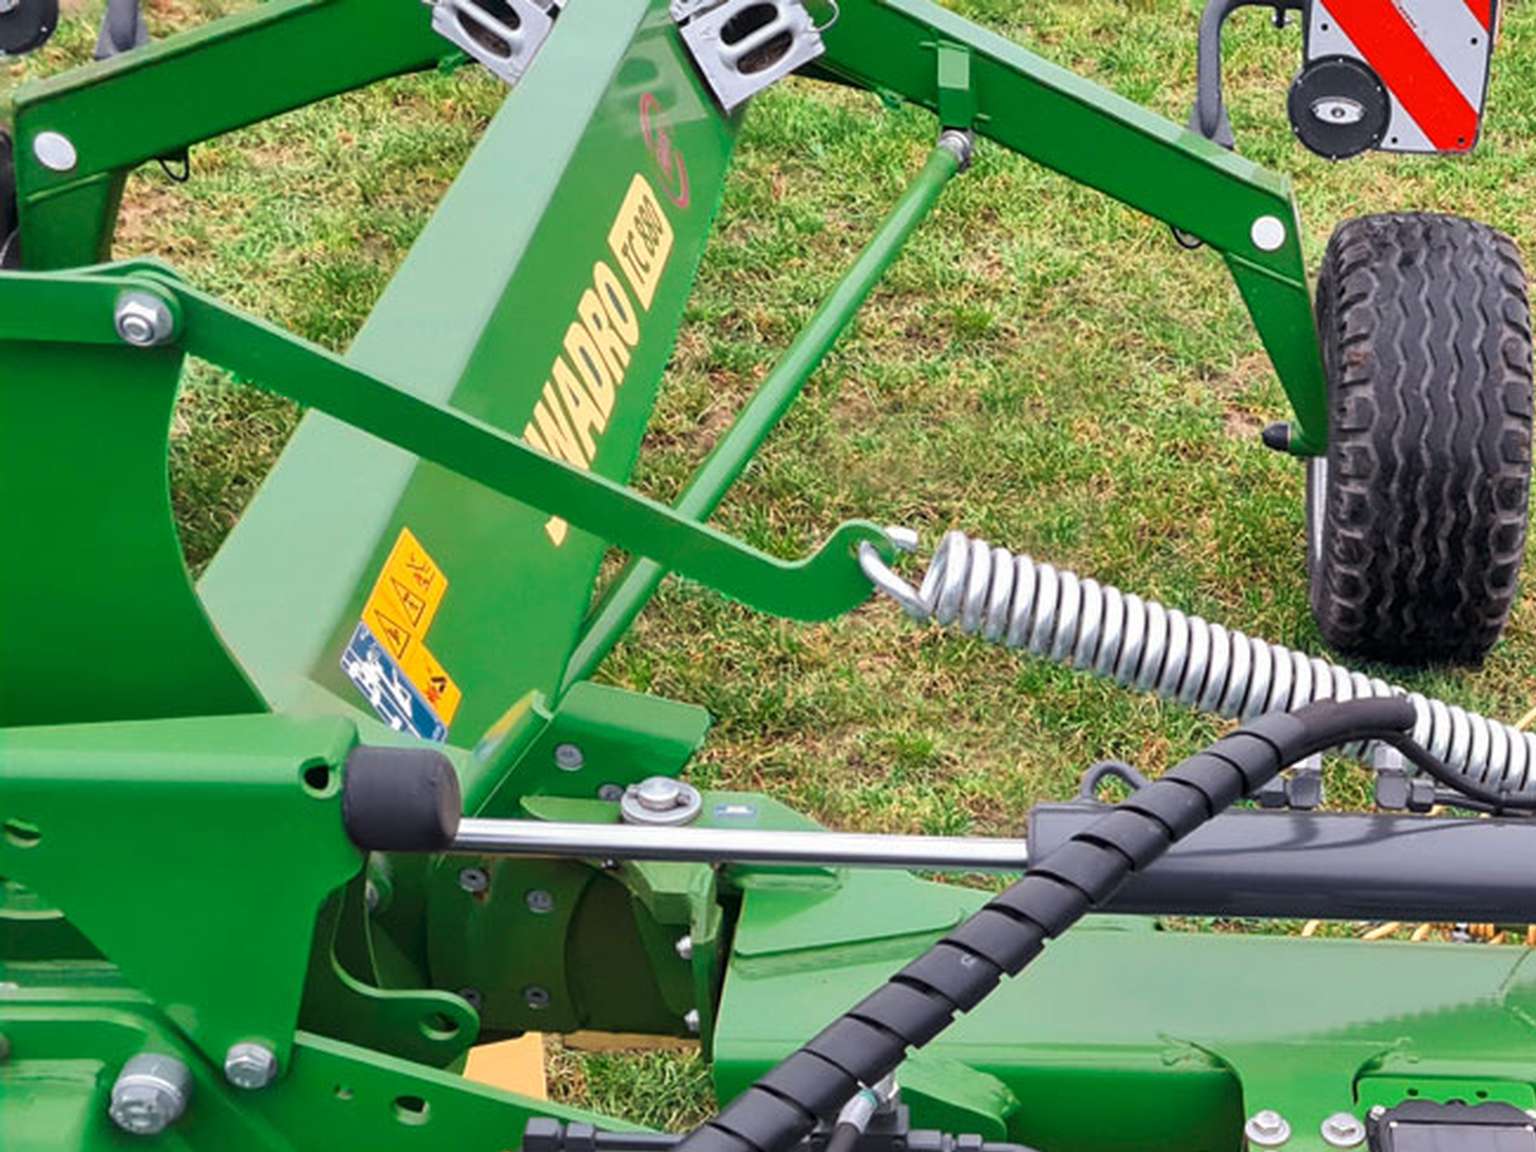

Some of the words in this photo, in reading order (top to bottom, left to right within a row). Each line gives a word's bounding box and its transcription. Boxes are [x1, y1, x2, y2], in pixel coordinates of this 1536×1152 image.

[621, 229, 651, 285] TC
[633, 194, 663, 258] 880
[523, 261, 640, 547] WADRO
